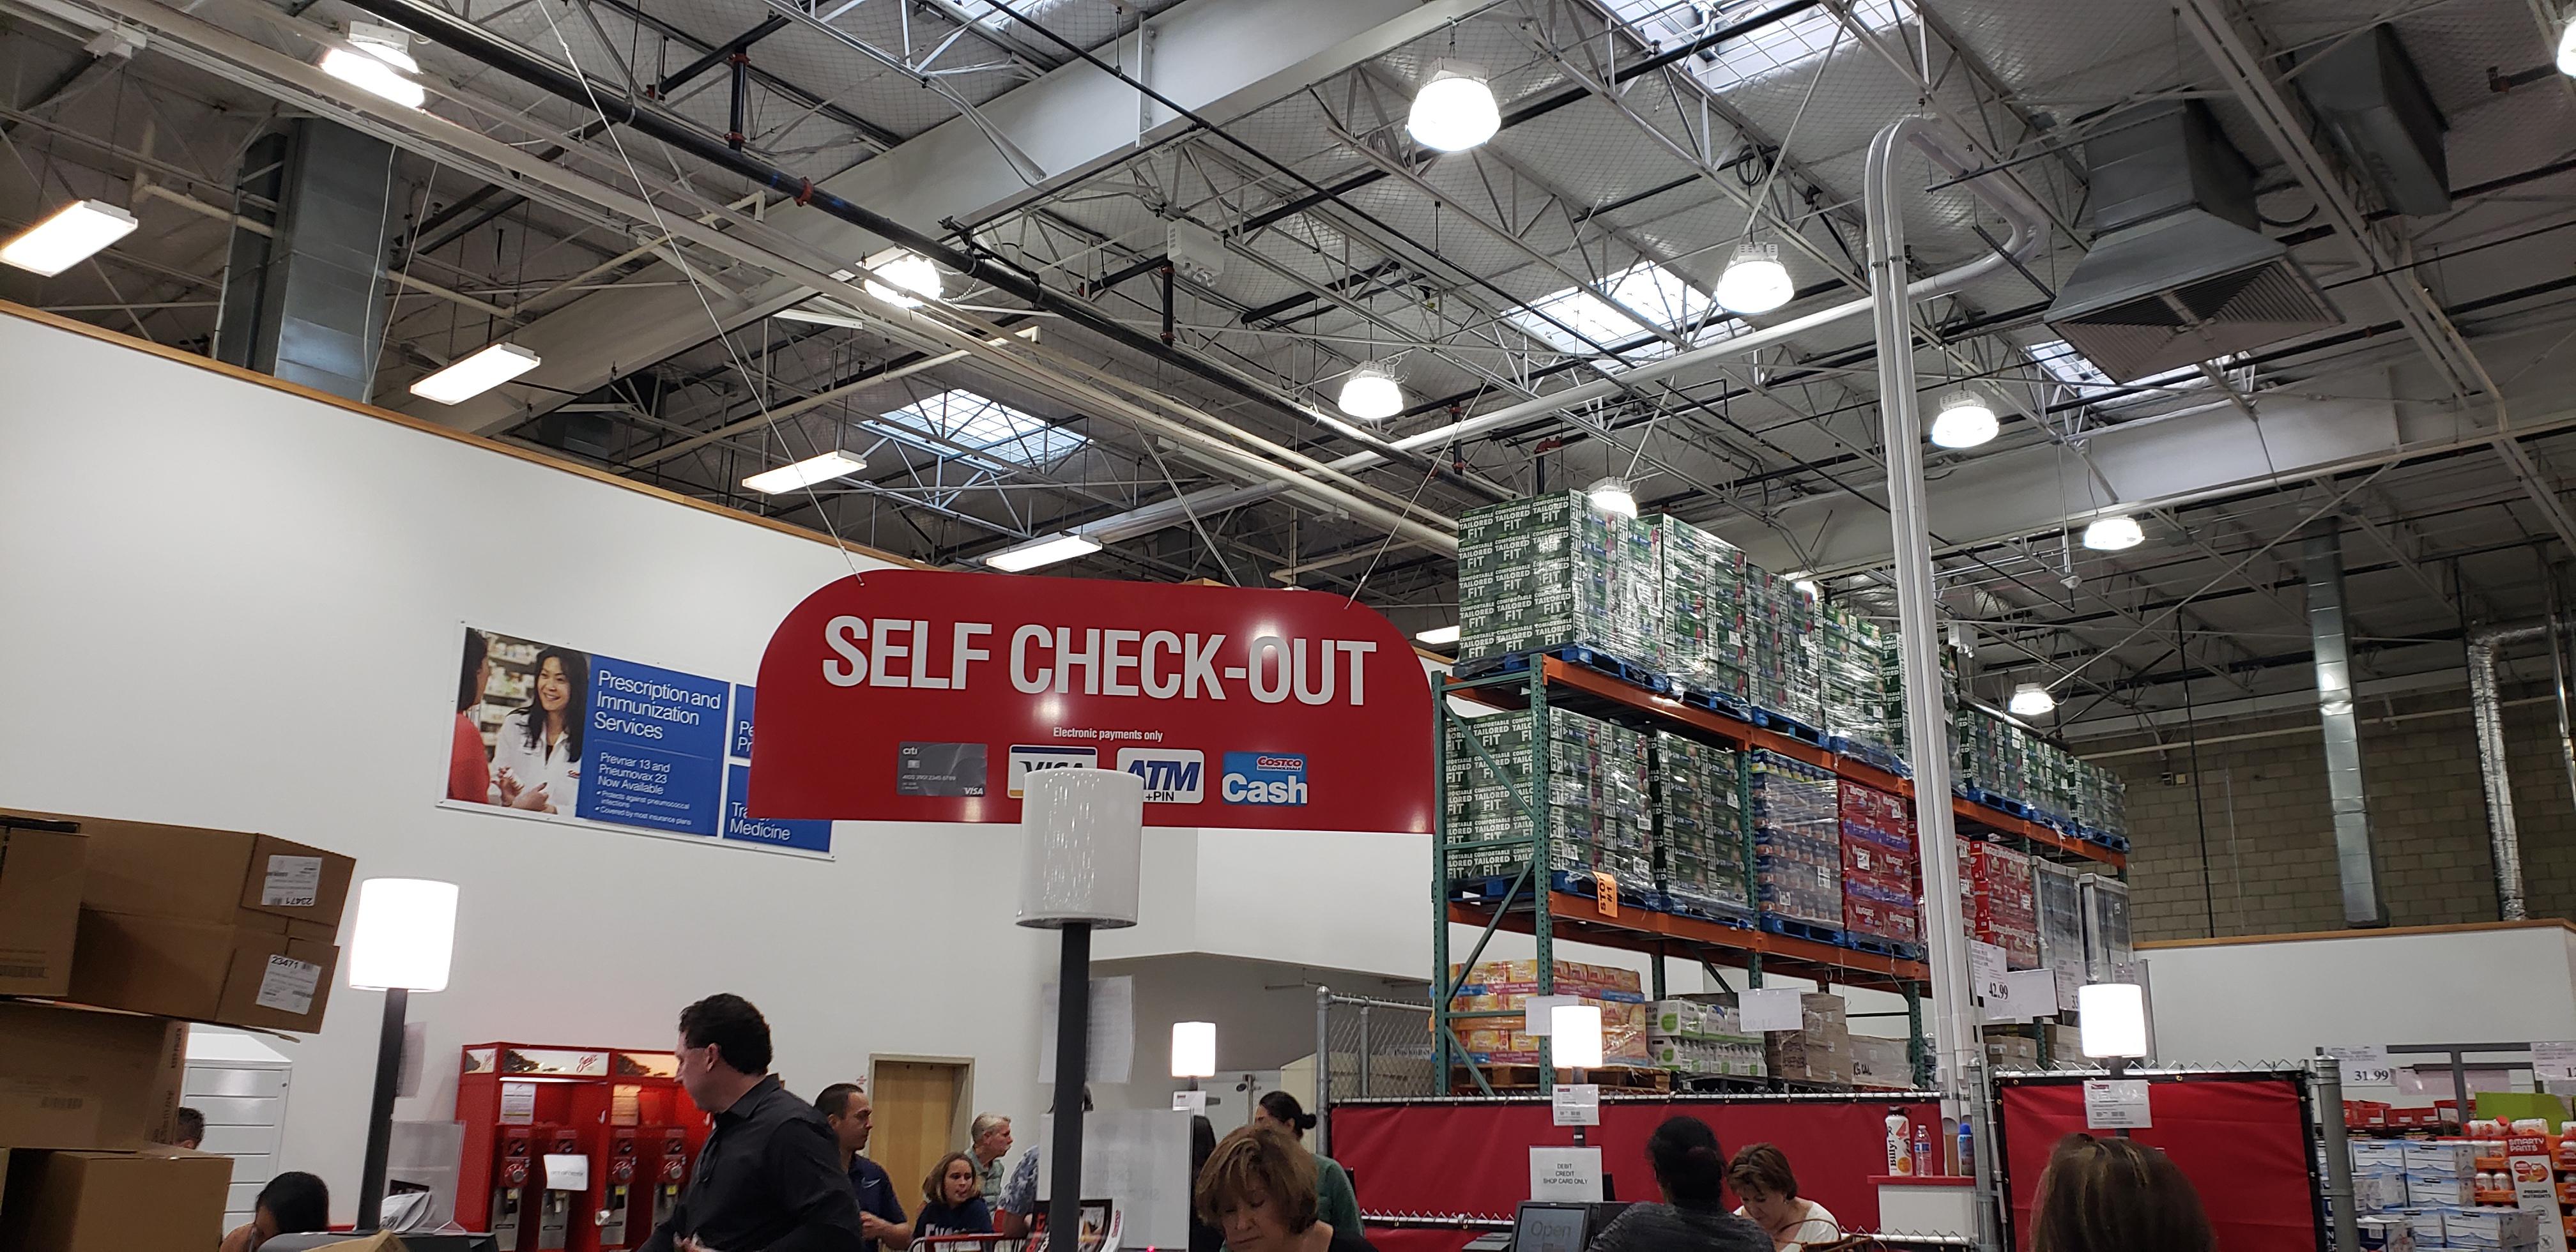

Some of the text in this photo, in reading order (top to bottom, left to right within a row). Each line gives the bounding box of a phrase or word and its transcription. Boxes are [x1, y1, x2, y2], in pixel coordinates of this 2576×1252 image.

[1533, 496, 1569, 507] COMFORTABLE
[1533, 501, 1569, 514] TAILORED
[1495, 504, 1530, 515] COMFORTABLE
[1459, 512, 1493, 523] COMFORTABLE
[1495, 510, 1530, 523] TAILORED
[1542, 510, 1560, 523] FIT
[1459, 518, 1493, 530] TAILORED
[1504, 519, 1522, 531] FIT
[1468, 526, 1485, 539] FIT
[1533, 526, 1569, 537] COMFORTABLE
[1495, 534, 1529, 544] COMFORTABLE
[1459, 542, 1492, 553] COMFORTABLE
[1495, 540, 1529, 552] TAILORED
[1459, 548, 1492, 560] TAILORED
[1503, 548, 1522, 561] FIT
[1468, 556, 1485, 569] FIT
[1495, 564, 1531, 575] COMFORTABLE
[1496, 570, 1530, 581] TAILORED
[1459, 572, 1493, 583] COMFORTABLE
[1459, 577, 1493, 589] TAILORED
[1542, 571, 1560, 584] FIT
[1504, 579, 1522, 590] FIT
[1468, 586, 1485, 598] FIT
[1496, 594, 1532, 605] COMFORTABLE
[1535, 593, 1571, 605] TAILORED
[1460, 602, 1494, 612] COMFORTABLE
[1496, 600, 1532, 612] TAILORED
[1544, 602, 1562, 615] FIT
[1460, 607, 1494, 619] TAILORED
[1505, 609, 1523, 621] FIT
[1469, 616, 1486, 629] FIT
[1535, 618, 1572, 629] COMFORTABLE
[1535, 624, 1572, 636] TAILORED
[1460, 632, 1494, 641] COMFORTABLE
[1496, 631, 1532, 644] TAILORED
[1545, 632, 1564, 645] FIT
[1460, 637, 1494, 649] TAILORED
[1506, 639, 1524, 652] FIT
[1469, 646, 1486, 658] FIT
[822, 615, 1377, 706] SELF CHECK-OUT
[598, 670, 721, 710] Prescription and
[597, 691, 700, 726] Immunization
[594, 712, 663, 740] Services
[1473, 719, 1509, 729] COMFORTABLE
[1054, 727, 1163, 742] Electronic payments only
[1473, 726, 1509, 736] TAILORED
[1446, 739, 1463, 751] FIT
[1482, 734, 1501, 746] FIT
[902, 747, 918, 755] citi
[600, 752, 670, 773] Prevnar 13 and
[1257, 756, 1303, 767] COSTCO
[599, 764, 667, 784] Pneumovax 23
[1127, 760, 1201, 791] ATM
[1446, 772, 1463, 783] FIT
[598, 775, 664, 795] Now Available
[1222, 773, 1307, 804] Cash
[1146, 791, 1174, 802] +PIN
[1475, 791, 1510, 801] TAILORED
[1447, 804, 1464, 814] FIT
[1483, 798, 1501, 811] FIT
[600, 806, 625, 816] Covered
[625, 810, 633, 818] by
[649, 814, 675, 824] insurance
[1475, 817, 1510, 825] COMFORTABLE
[730, 818, 791, 841] Medicine
[1475, 823, 1510, 833] TAILORED
[1475, 855, 1510, 865] TAILORED
[1447, 867, 1464, 879] FIT
[1483, 864, 1501, 876] FIT
[271, 956, 298, 969] 23471
[1989, 981, 2009, 1000] 42.99
[2354, 1069, 2389, 1081] 31.99
[1531, 1221, 1570, 1237] Open
